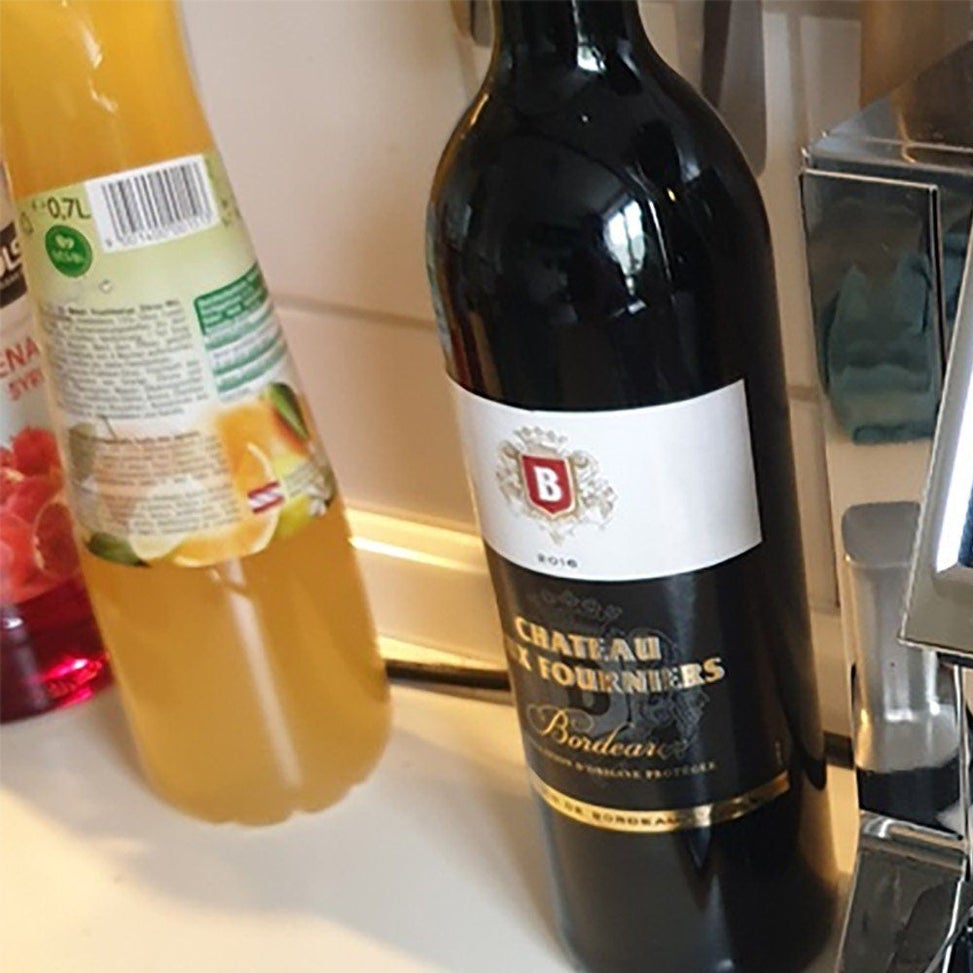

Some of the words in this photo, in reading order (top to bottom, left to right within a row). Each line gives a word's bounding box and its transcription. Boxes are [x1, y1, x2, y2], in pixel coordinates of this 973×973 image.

[532, 465, 563, 502] B
[537, 553, 578, 569] 2016
[514, 616, 662, 663] CHATEAU
[537, 657, 725, 695] FOURNIERS
